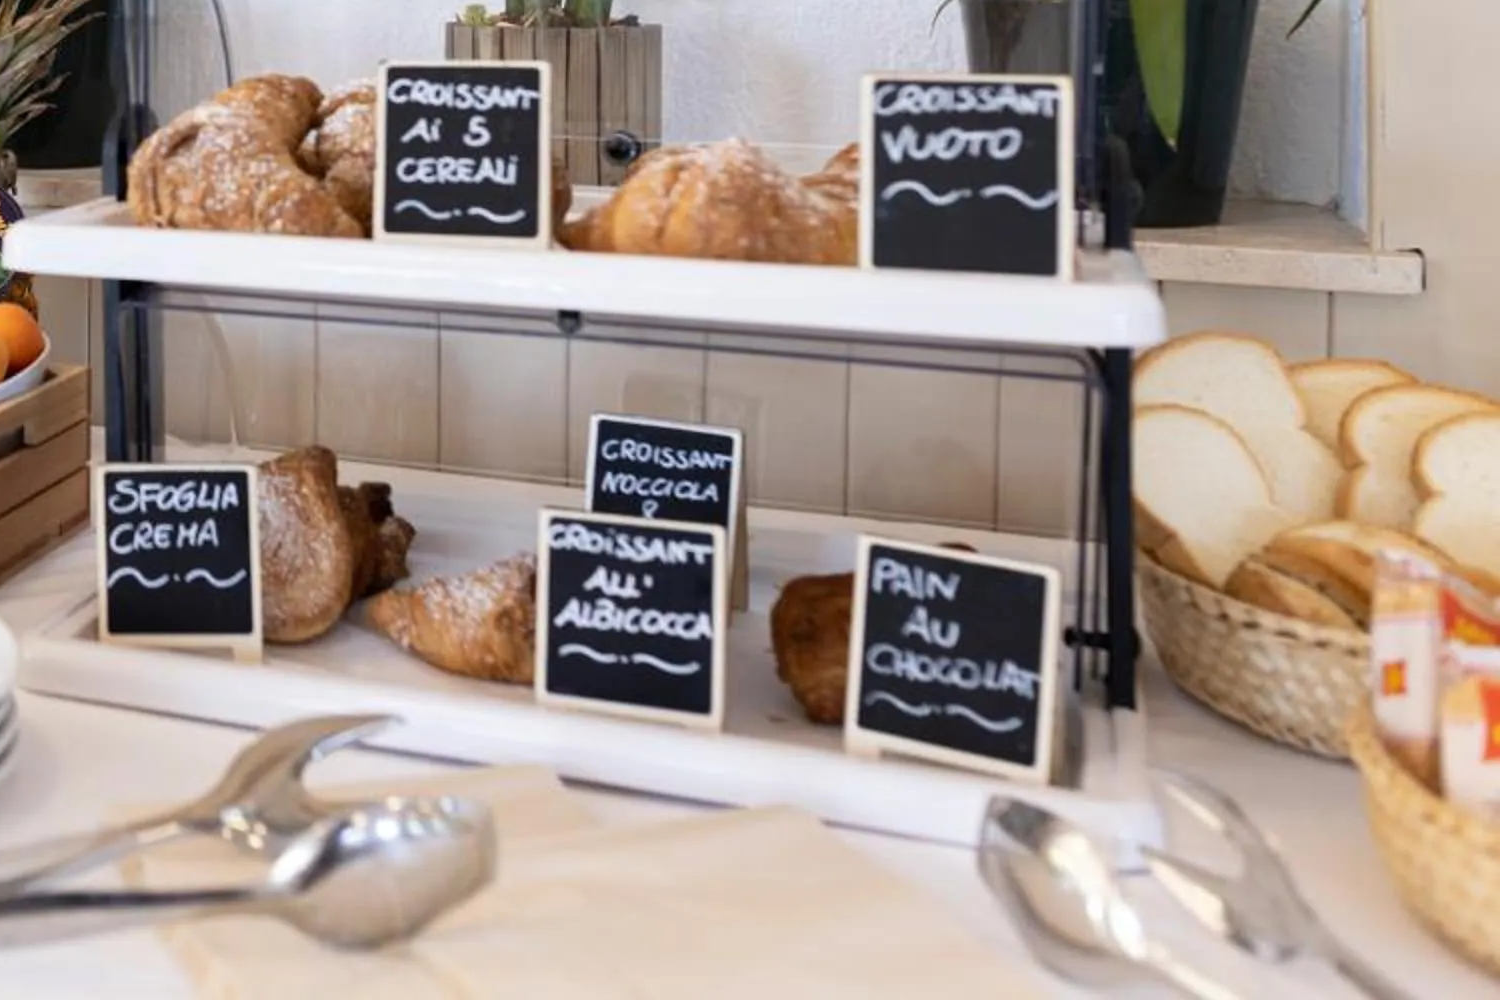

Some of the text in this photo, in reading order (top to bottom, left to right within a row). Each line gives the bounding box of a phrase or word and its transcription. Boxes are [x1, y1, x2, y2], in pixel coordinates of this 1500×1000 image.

[387, 78, 540, 110] CROISSANT
[874, 83, 1059, 117] CROISSANT
[881, 124, 1023, 163] VUOTO
[601, 438, 733, 470] CROISSANT
[108, 479, 239, 514] SFOGLIA
[601, 470, 719, 502] NOCCIOLA
[109, 518, 219, 554] CREMA
[583, 565, 653, 599] ALL'
[872, 557, 961, 601] PAIN
[553, 598, 713, 639] ALBICOCCA
[902, 605, 960, 648] AU
[865, 643, 1043, 700] CHOCOLAT
